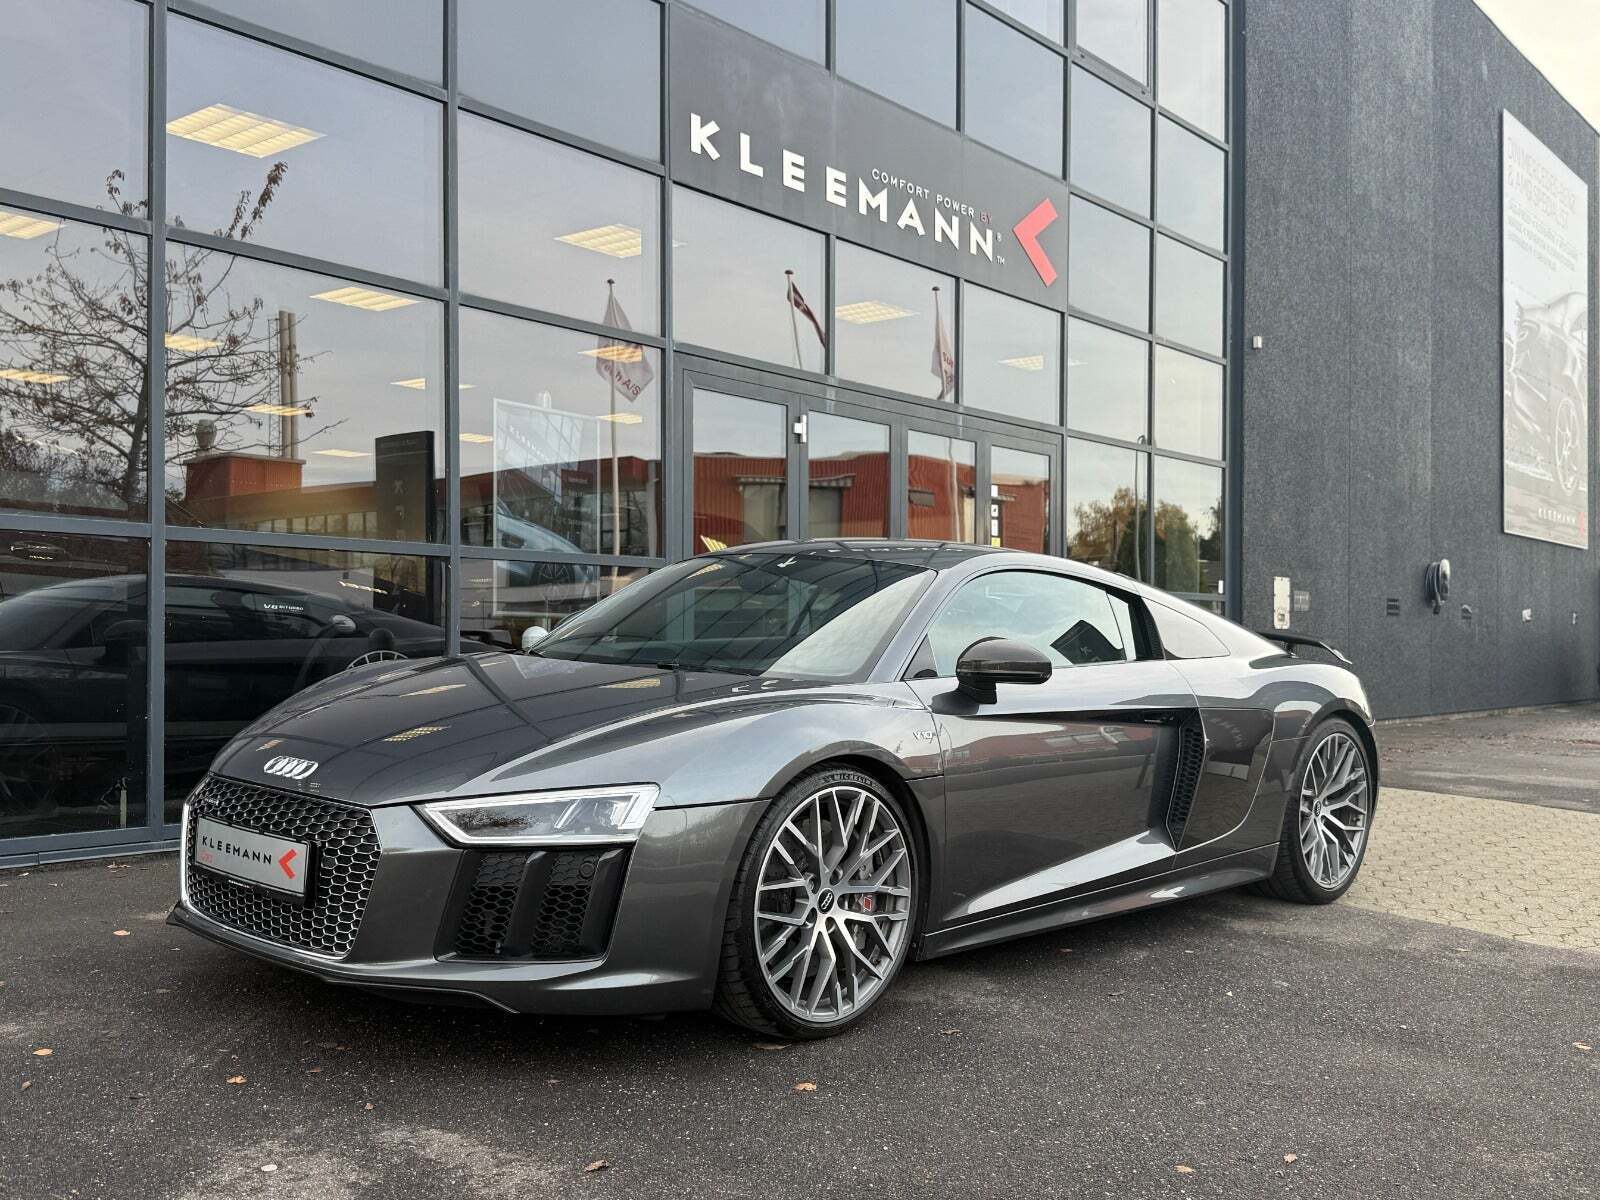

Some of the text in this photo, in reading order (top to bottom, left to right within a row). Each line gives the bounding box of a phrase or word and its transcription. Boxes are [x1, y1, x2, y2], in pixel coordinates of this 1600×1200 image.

[690, 113, 993, 262] KLEEMANN
[871, 167, 992, 225] COMFORT POWER BY
[202, 835, 272, 865] KLEEMANN
